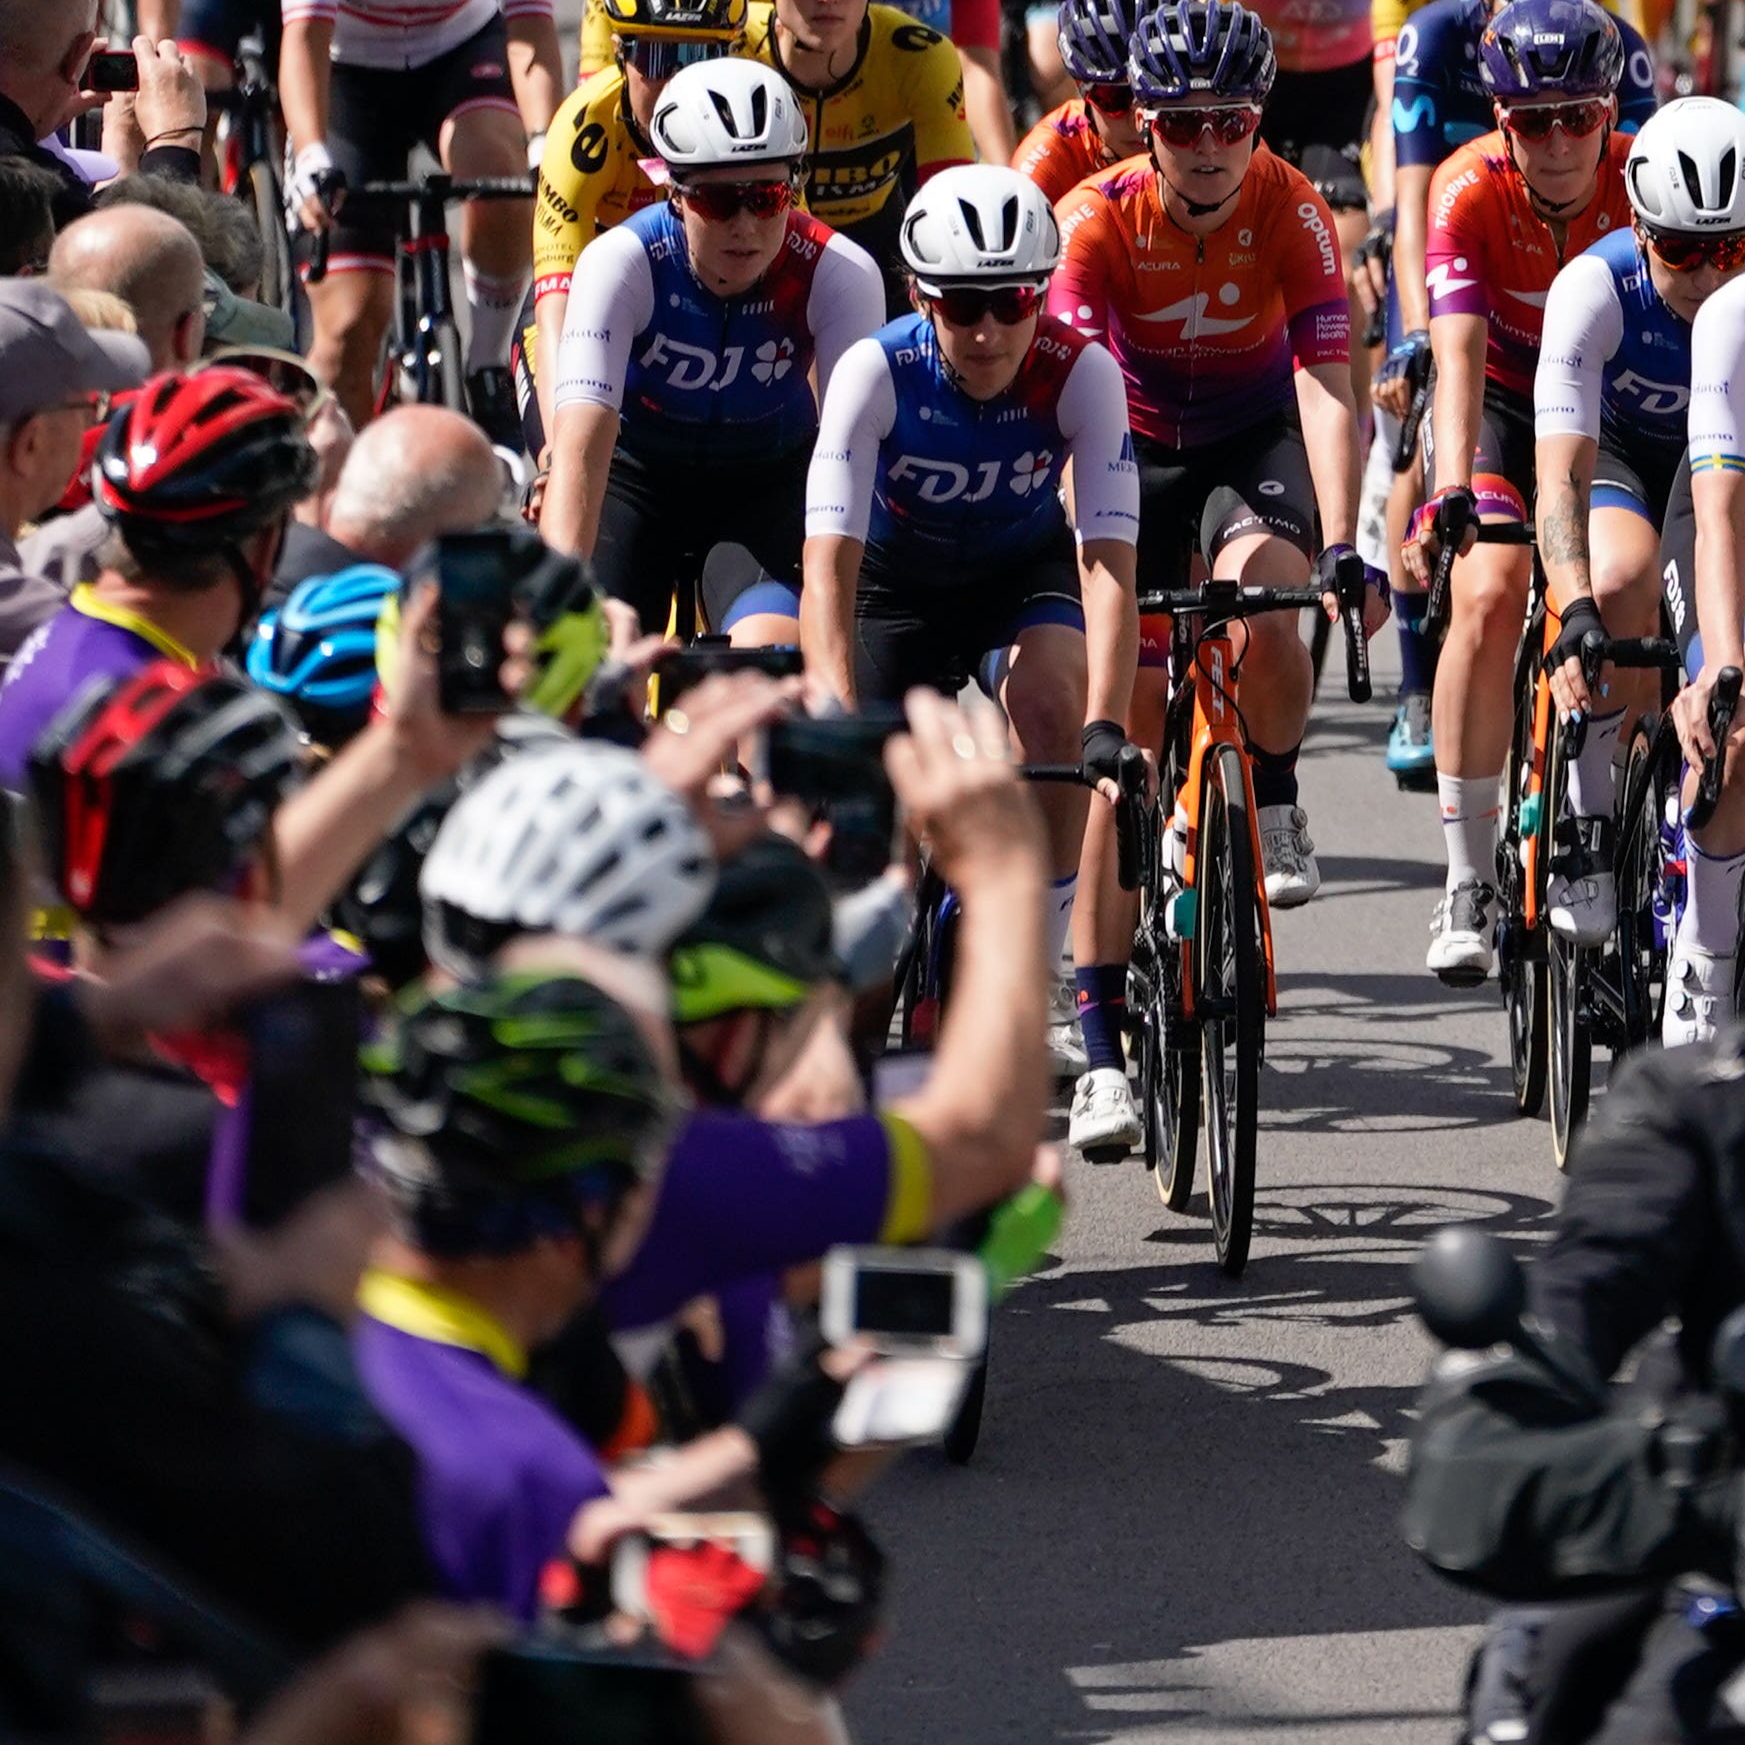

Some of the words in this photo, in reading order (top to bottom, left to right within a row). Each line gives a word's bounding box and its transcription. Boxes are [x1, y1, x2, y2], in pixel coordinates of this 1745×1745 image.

[664, 11, 702, 23] LAZER
[730, 143, 768, 154] LAZER
[1434, 168, 1481, 231] THORNE
[1296, 202, 1338, 276] Optum
[1694, 216, 1732, 226] LAZER
[975, 257, 1016, 269] LAZER
[1137, 260, 1182, 272] ACURA
[639, 332, 745, 392] FDJ
[1611, 368, 1692, 415] FD
[887, 454, 1002, 504] FDJ
[1222, 514, 1301, 540] PACTIMO
[1209, 643, 1226, 720] FELT
